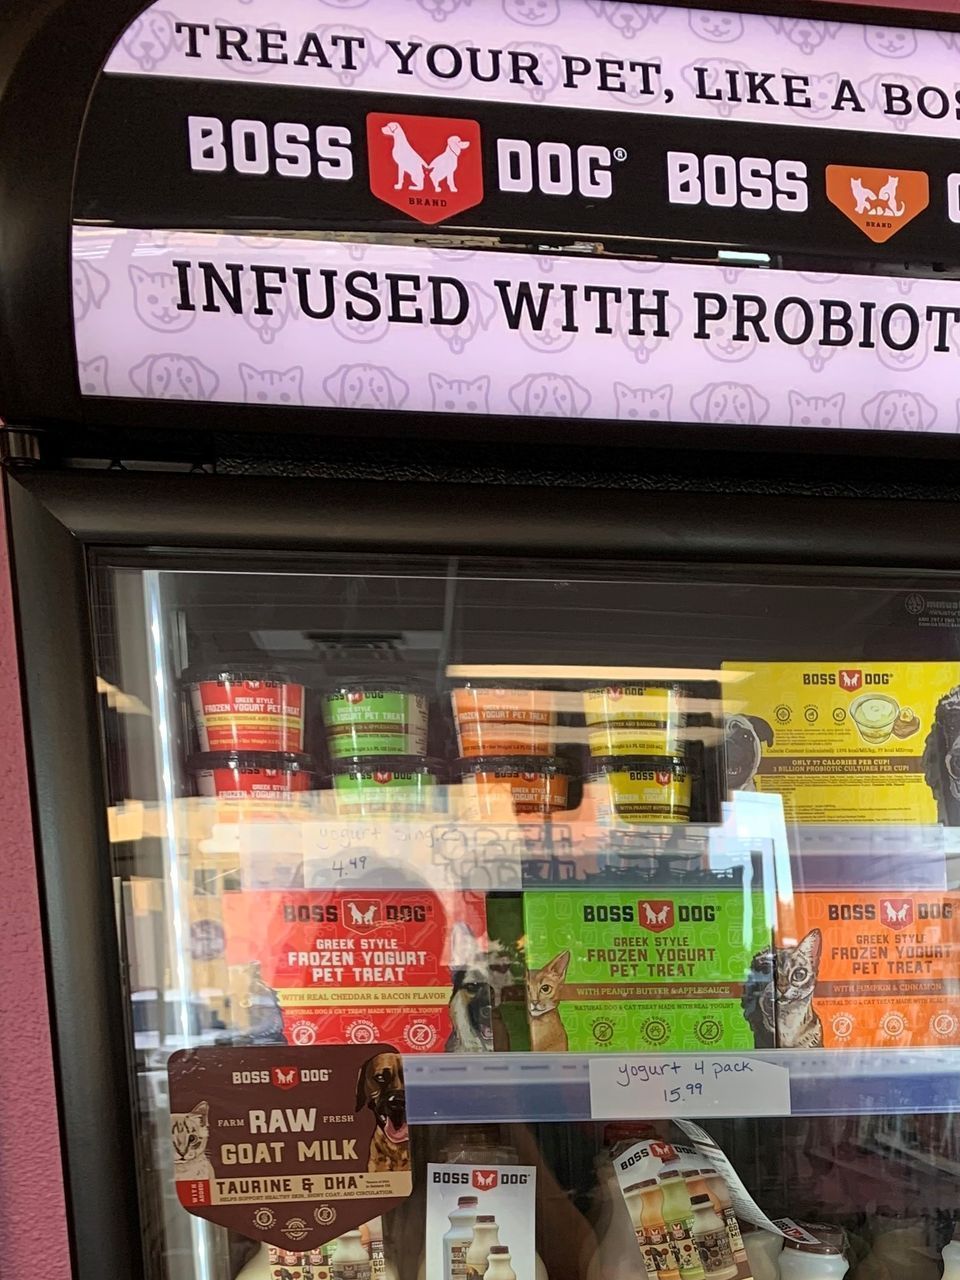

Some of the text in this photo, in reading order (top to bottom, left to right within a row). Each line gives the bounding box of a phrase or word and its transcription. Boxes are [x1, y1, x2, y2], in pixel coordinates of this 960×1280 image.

[174, 22, 365, 71] TREAT
[385, 40, 543, 87] YOUR
[562, 55, 675, 103] PET,
[694, 66, 813, 109] LIKE
[832, 79, 867, 113] A
[188, 115, 354, 181] BOSS
[666, 150, 809, 213] BOSS
[172, 260, 470, 325] INFUSED
[494, 279, 670, 338] WITH
[331, 855, 368, 878] 4.49
[583, 905, 634, 922] BOSS
[828, 904, 876, 920] BOSS
[614, 937, 689, 947] GREEK STYLE
[288, 952, 427, 966] FROZEN YOGURT
[588, 949, 716, 962] FROZEN YOGURT
[312, 968, 405, 982] PET TREAT
[610, 964, 696, 977] PET TREAT
[232, 1071, 270, 1084] BOSS
[616, 1060, 754, 1087] yogurt 4 pack
[663, 1081, 704, 1103] 15.99
[249, 1107, 317, 1134] RAW
[221, 1138, 359, 1166] GOAT MILK
[216, 1178, 292, 1196] TAURINE
